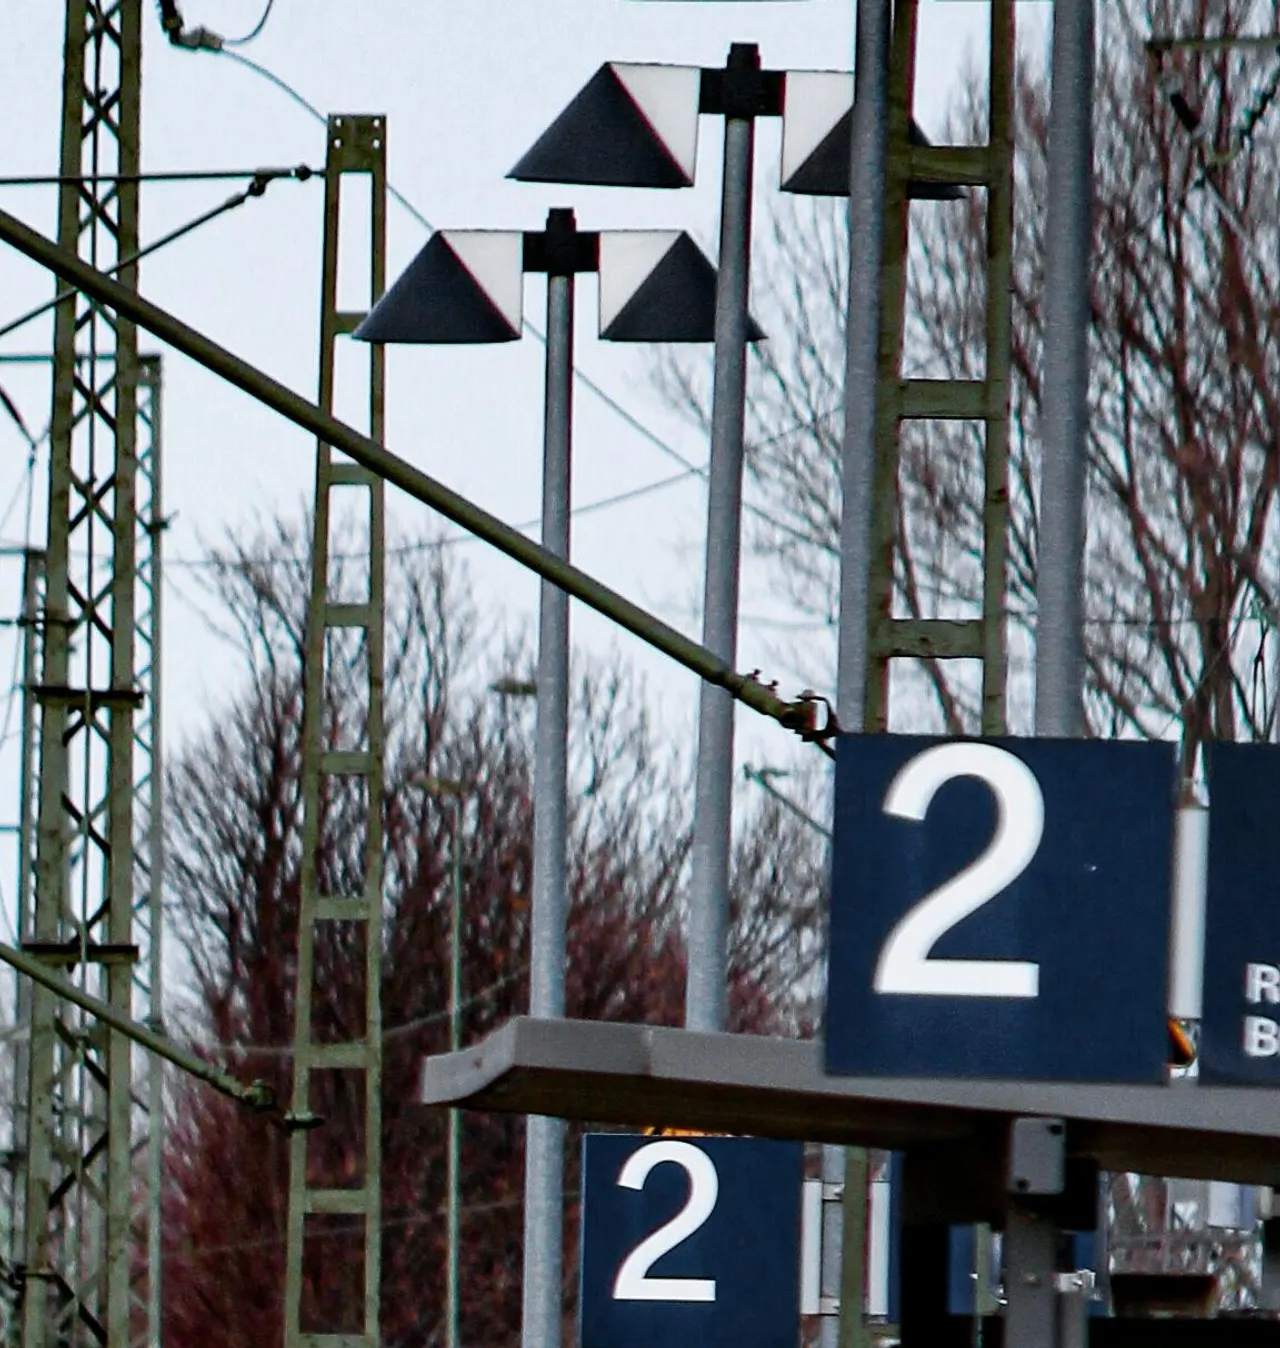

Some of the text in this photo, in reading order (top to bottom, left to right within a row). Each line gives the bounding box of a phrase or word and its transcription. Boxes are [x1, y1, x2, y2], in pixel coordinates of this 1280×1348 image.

[873, 742, 1045, 998] 2
[1245, 962, 1280, 1004] R
[1244, 1015, 1280, 1058] B
[612, 1140, 720, 1303] 2
